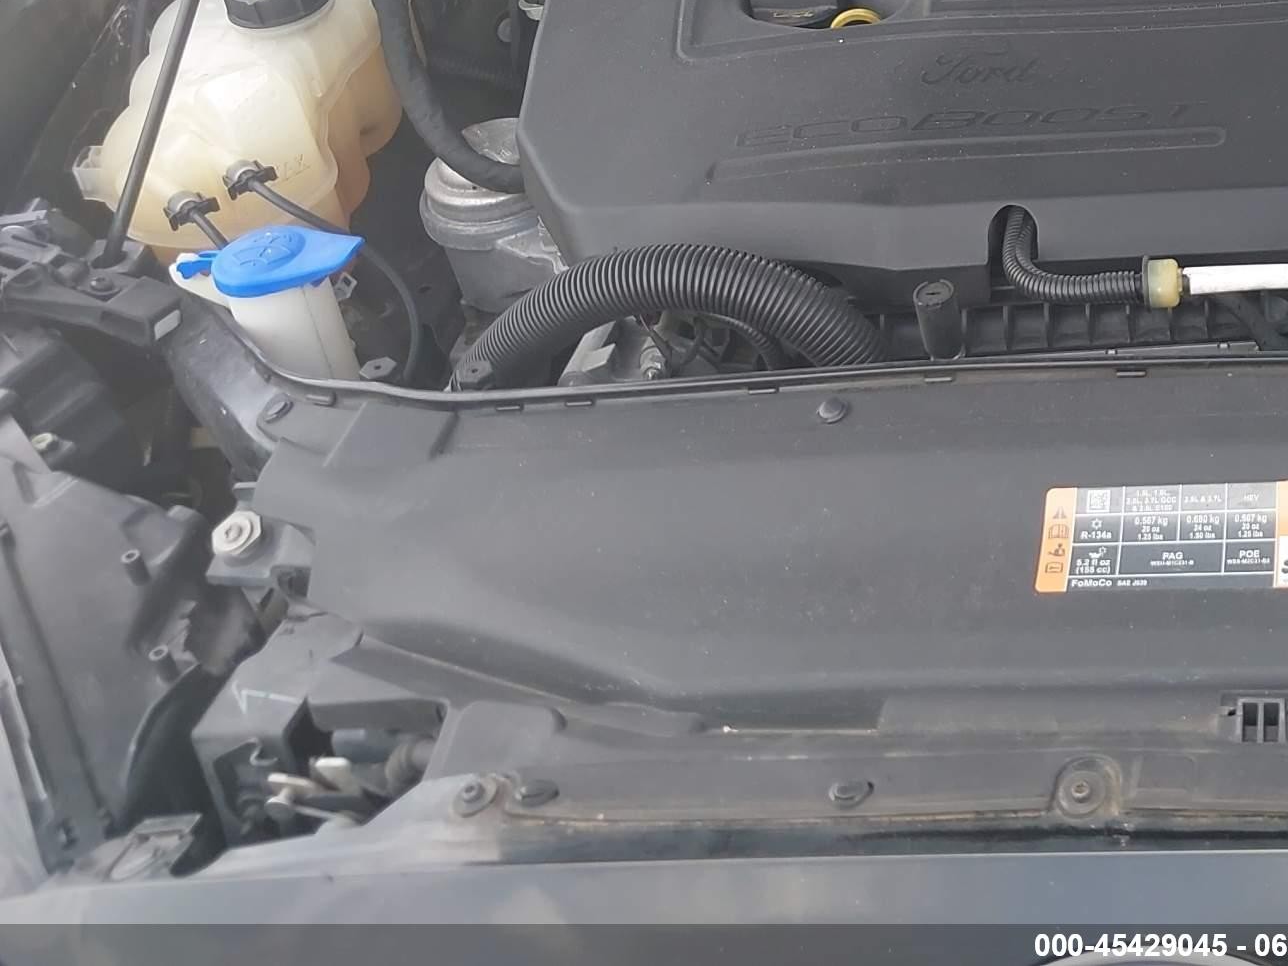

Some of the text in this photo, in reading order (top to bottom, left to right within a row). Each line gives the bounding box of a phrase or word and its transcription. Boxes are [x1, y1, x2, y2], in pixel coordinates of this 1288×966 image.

[920, 52, 1042, 85] Ford
[1157, 516, 1169, 527] kg
[1209, 514, 1220, 525] kg
[1257, 513, 1268, 524] kg
[1203, 524, 1213, 532] oz
[1080, 530, 1112, 539] R-134a
[1161, 552, 1184, 560] PAG
[1239, 549, 1261, 558] POE
[1071, 579, 1113, 587] FoMoCo
